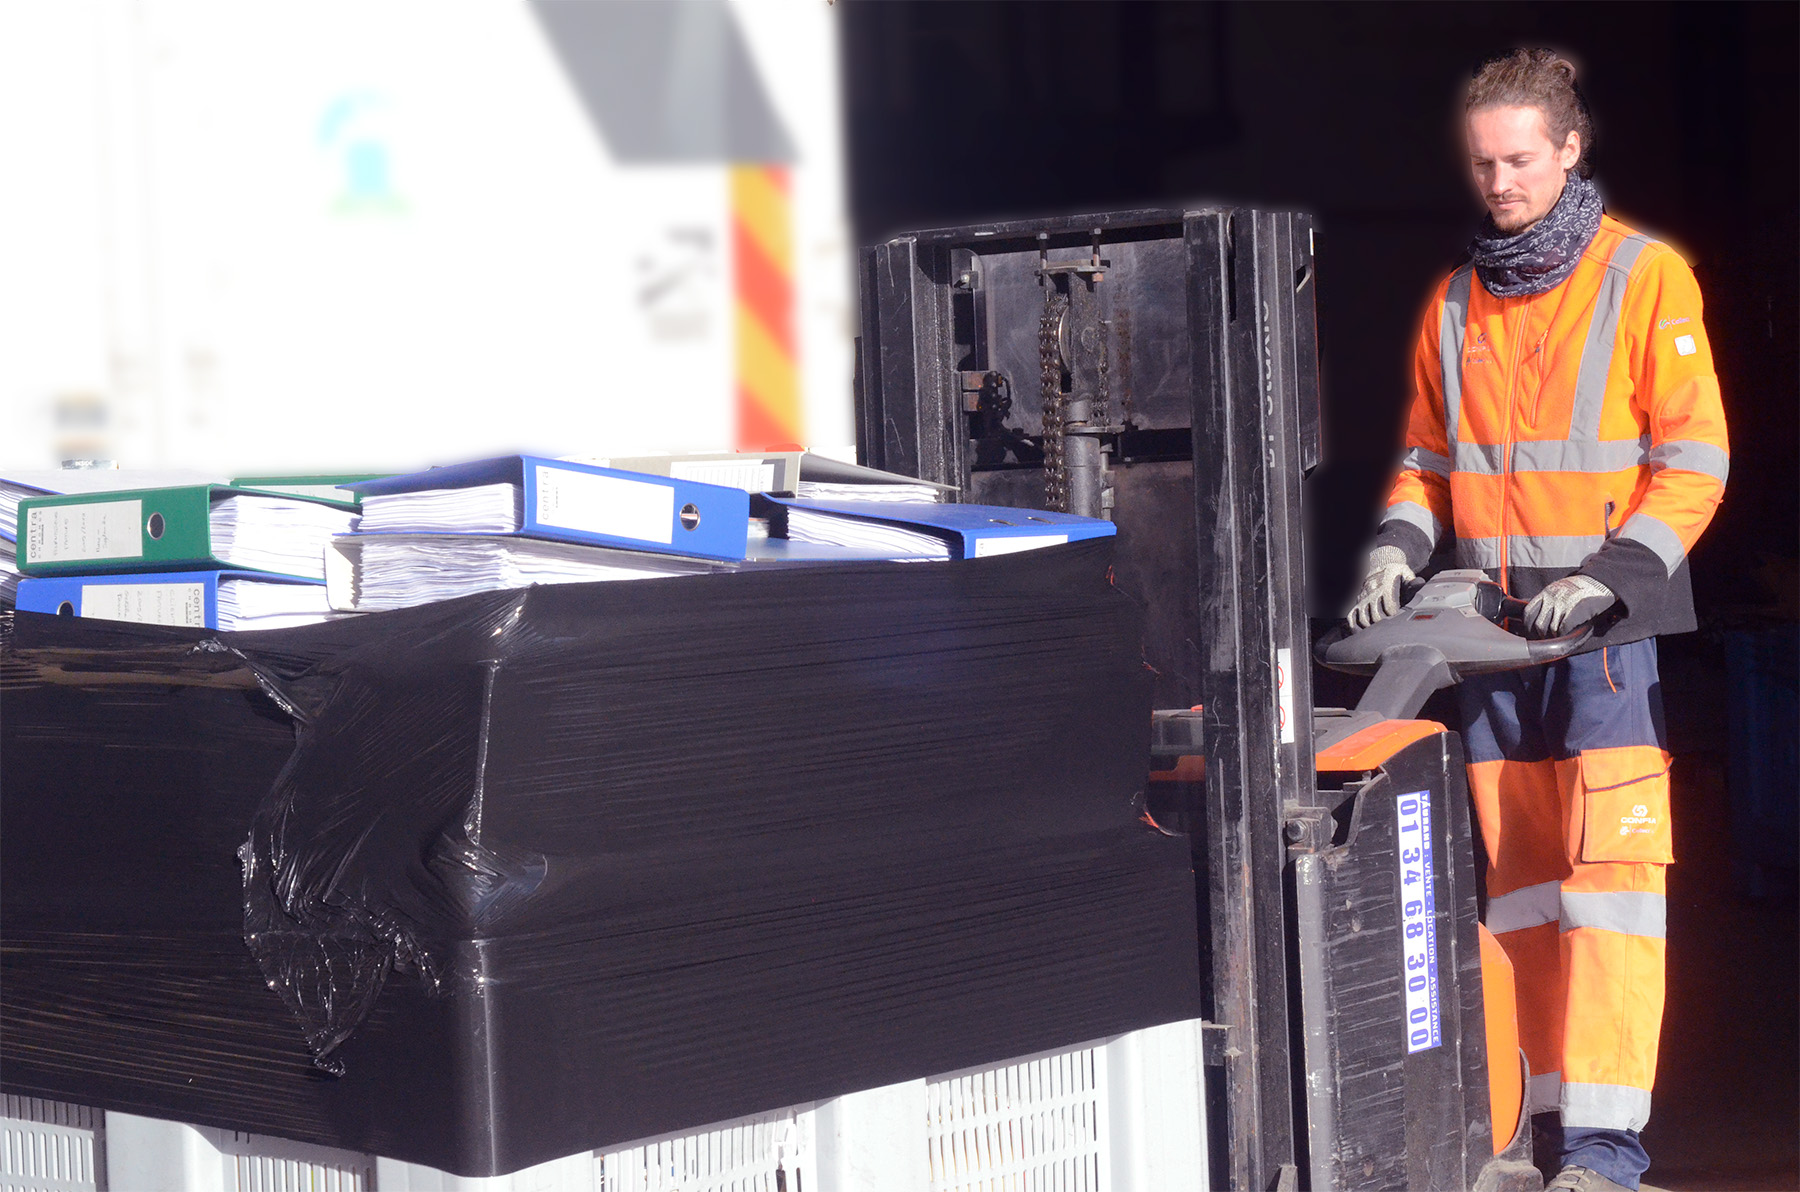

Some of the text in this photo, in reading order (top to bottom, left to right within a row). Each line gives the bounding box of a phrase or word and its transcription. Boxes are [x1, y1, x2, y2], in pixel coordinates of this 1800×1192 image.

[30, 511, 38, 559] centra
[193, 588, 202, 628] centr
[1424, 861, 1433, 898] VENTE
[1400, 799, 1429, 1046] 01 34 68 30 00
[1426, 909, 1436, 964] LOCATION
[1429, 976, 1440, 1043] ASSISTANCE
